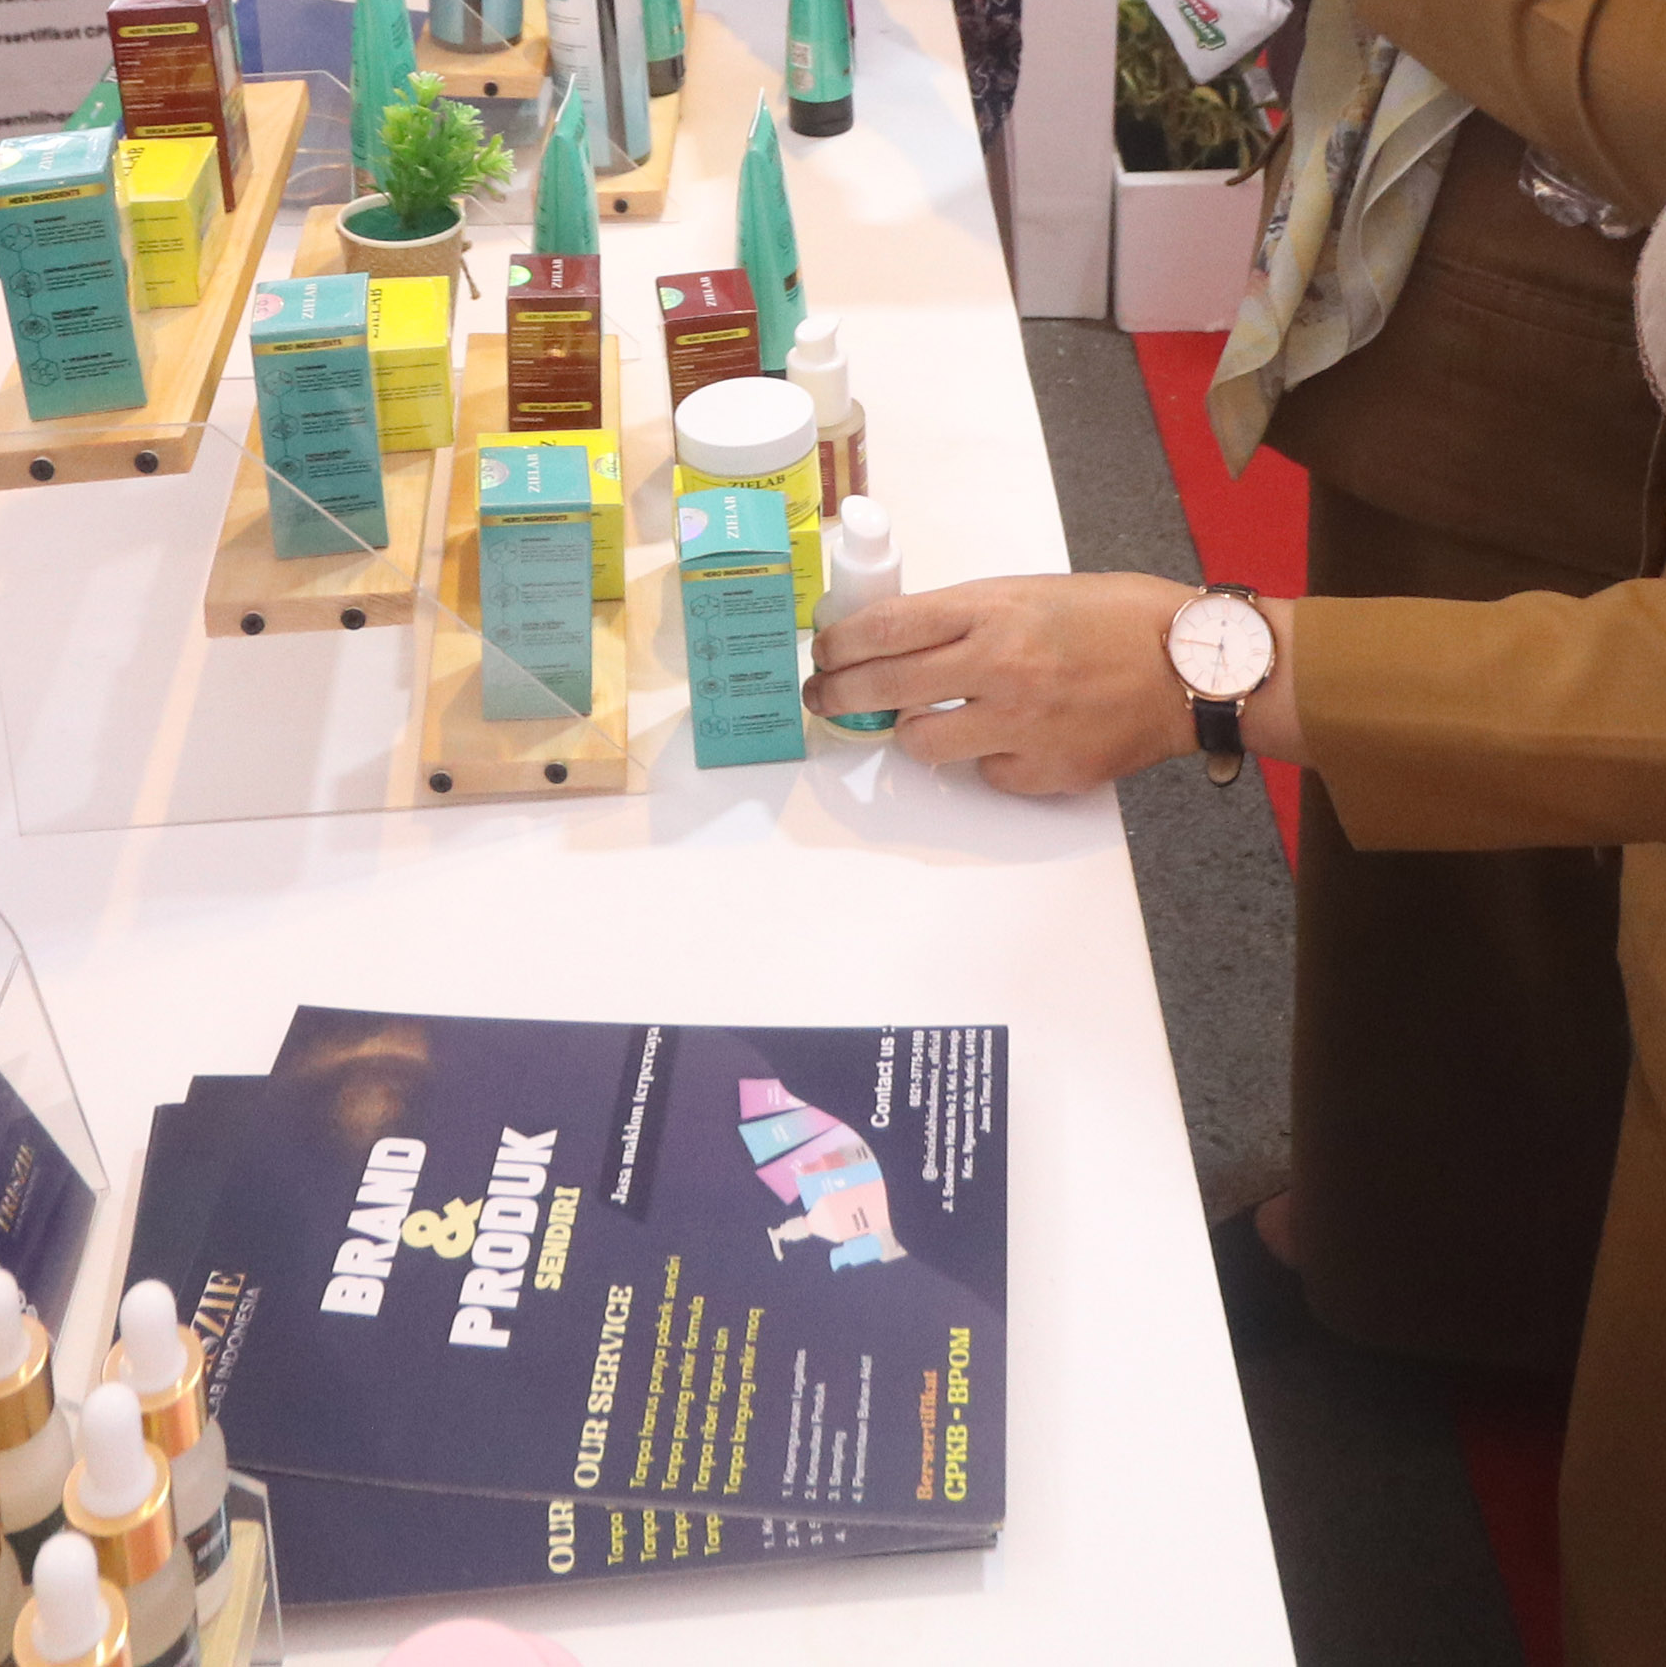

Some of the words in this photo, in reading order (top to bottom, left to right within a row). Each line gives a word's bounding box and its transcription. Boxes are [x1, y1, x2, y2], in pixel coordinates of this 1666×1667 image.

[300, 283, 319, 319] ZIELAB
[526, 452, 541, 494] ZIELAB
[723, 495, 740, 540] ZIELAB
[633, 1026, 662, 1102] terpercaya
[879, 1037, 895, 1057] us
[870, 1061, 893, 1128] Contact
[620, 1105, 644, 1164] maklon
[610, 1168, 633, 1204] Jasa
[320, 1137, 427, 1317] BRAND
[400, 1197, 483, 1260] &
[448, 1126, 557, 1349] PRODUK
[535, 1185, 581, 1291] SENDIRI
[215, 1286, 262, 1379] INDONESIA
[655, 1302, 674, 1346] pabrik
[682, 1295, 705, 1350] formula
[746, 1308, 765, 1340] moq
[587, 1285, 634, 1413] SERVICE
[647, 1348, 669, 1393] punya
[679, 1352, 697, 1388] mikir
[739, 1344, 756, 1379] mikir
[947, 1327, 970, 1404] BPOM
[707, 1355, 726, 1402] ngurus
[638, 1396, 659, 1436] harus
[672, 1391, 695, 1438] pusing
[700, 1404, 719, 1440] ribet
[730, 1383, 755, 1442] bingung
[916, 1370, 937, 1501] Bersertifikat
[574, 1421, 609, 1488] OUR
[630, 1440, 655, 1488] Tanpa
[662, 1442, 685, 1490] Tanpa
[693, 1444, 717, 1492] Tanpa
[723, 1446, 746, 1494] Tanpa
[943, 1425, 968, 1501] CPKB
[548, 1501, 575, 1573] OUR
[607, 1513, 626, 1565] Tanpa
[704, 1513, 723, 1555] Tanp
